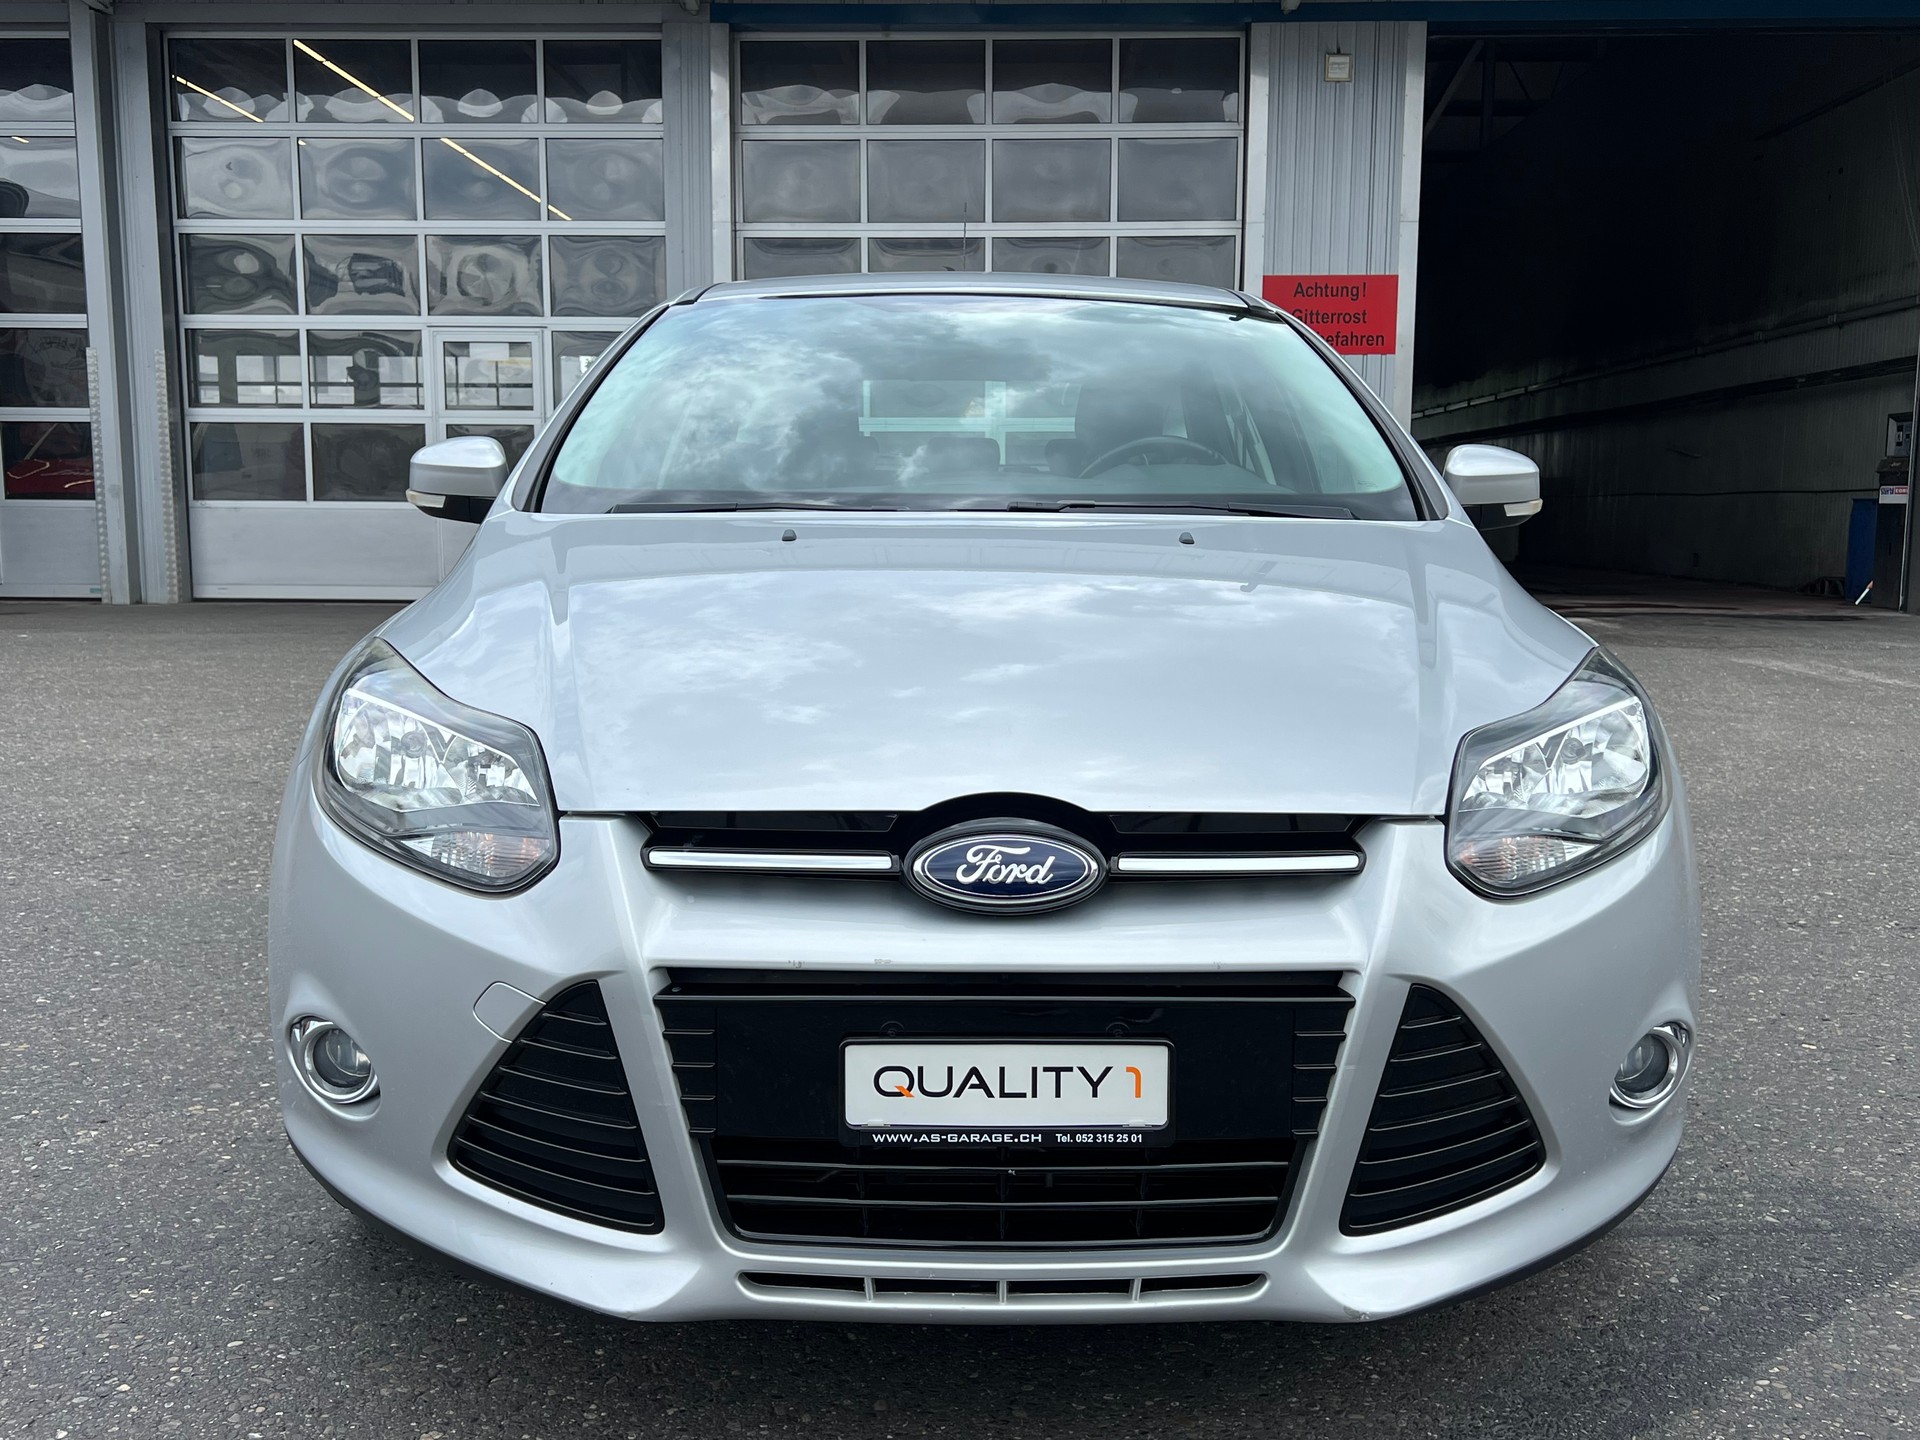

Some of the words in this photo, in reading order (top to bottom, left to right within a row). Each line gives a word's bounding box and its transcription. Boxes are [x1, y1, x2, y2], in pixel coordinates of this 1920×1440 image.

[1293, 281, 1367, 301] Achtung!
[1316, 331, 1386, 347] efahren
[956, 844, 1056, 885] Ford
[873, 1065, 1114, 1099] QUALITY
[1125, 1066, 1142, 1099] 1
[872, 1133, 1042, 1144] WWW.AS-GARAGE.CH
[1055, 1133, 1073, 1143] Tel.
[1075, 1133, 1094, 1143] 052
[1096, 1133, 1114, 1143] 315
[1116, 1133, 1129, 1143] 25
[1131, 1133, 1142, 1143] 01
